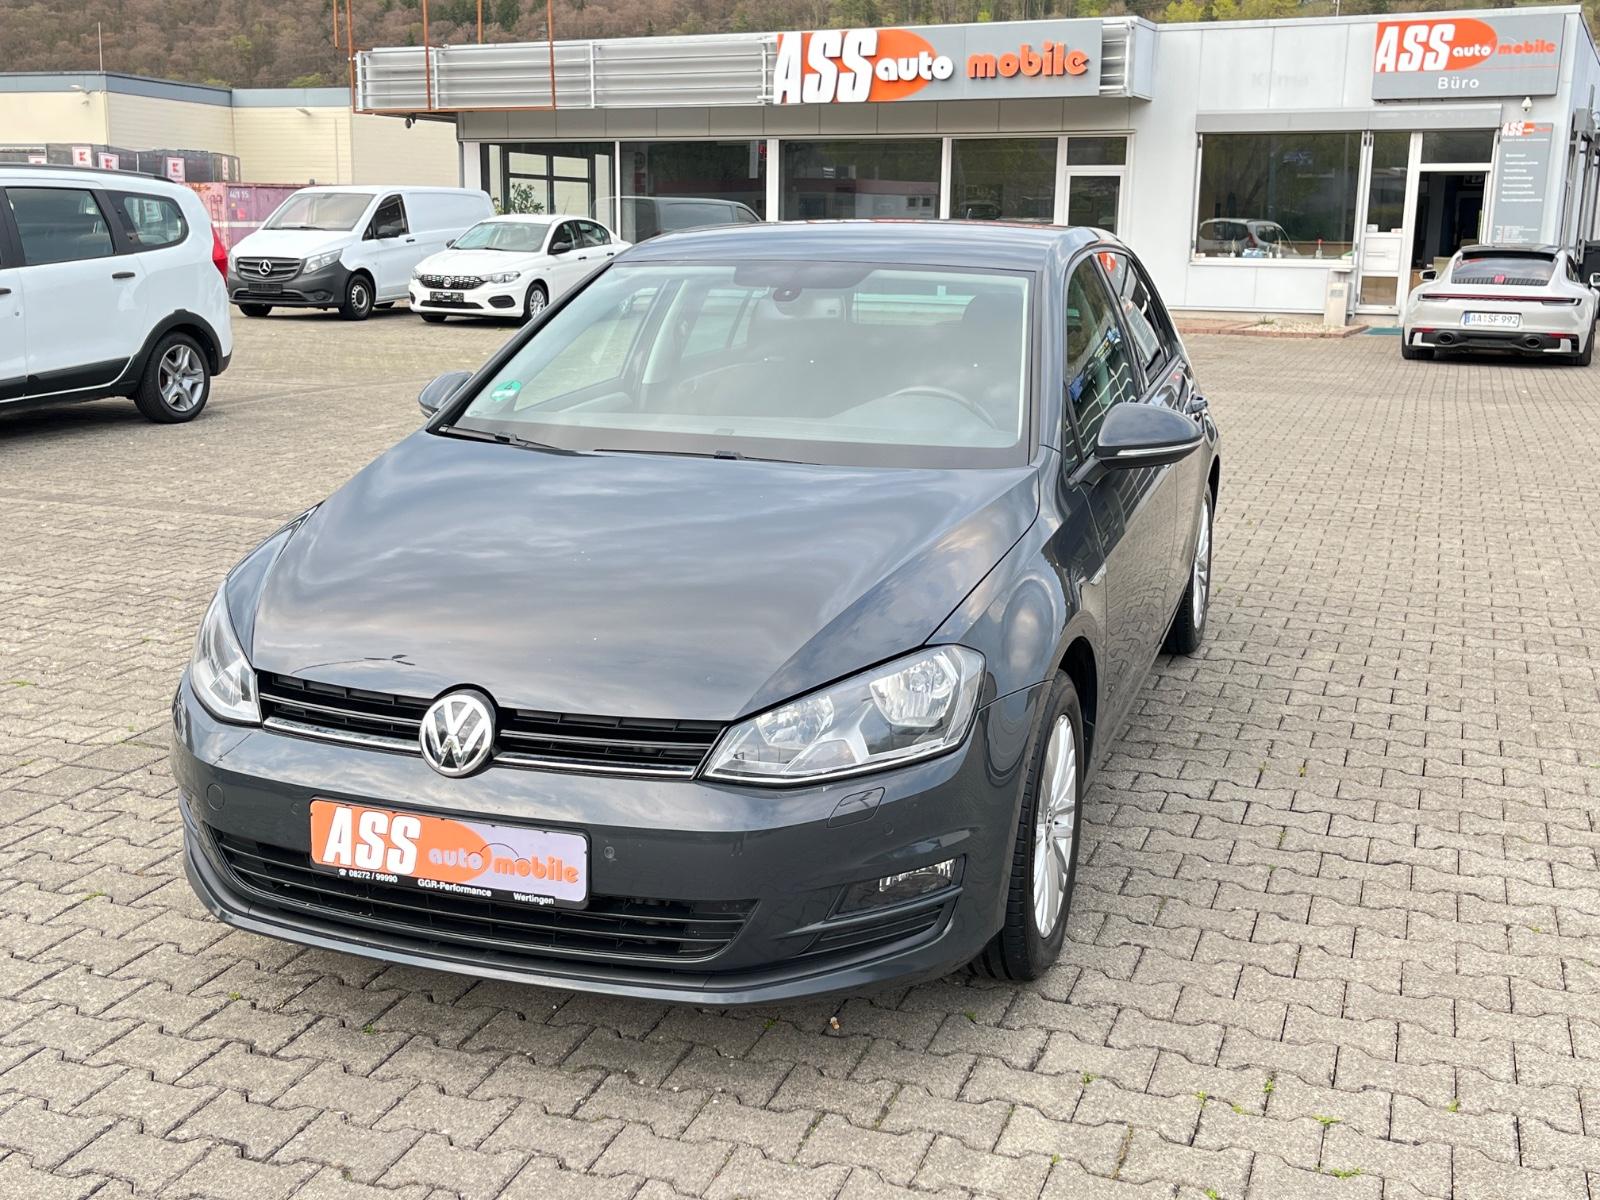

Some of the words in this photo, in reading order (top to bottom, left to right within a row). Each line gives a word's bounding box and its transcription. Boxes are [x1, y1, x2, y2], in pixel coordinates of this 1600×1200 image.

[1376, 23, 1456, 73] ASS
[1453, 44, 1492, 58] auto
[1497, 40, 1556, 56] mobile
[773, 29, 878, 105] ASS
[875, 51, 954, 82] auto
[967, 40, 1089, 80] mobile
[1437, 76, 1480, 90] Büro
[1501, 122, 1525, 136] ASS
[1501, 315, 1518, 325] 992
[322, 806, 422, 875] ASS
[428, 848, 484, 871] auto
[494, 855, 580, 884] mobile
[349, 870, 371, 881] 08272
[375, 874, 398, 883] 99990
[417, 878, 492, 898] GGR-Performance
[513, 892, 554, 905] Wertingen
